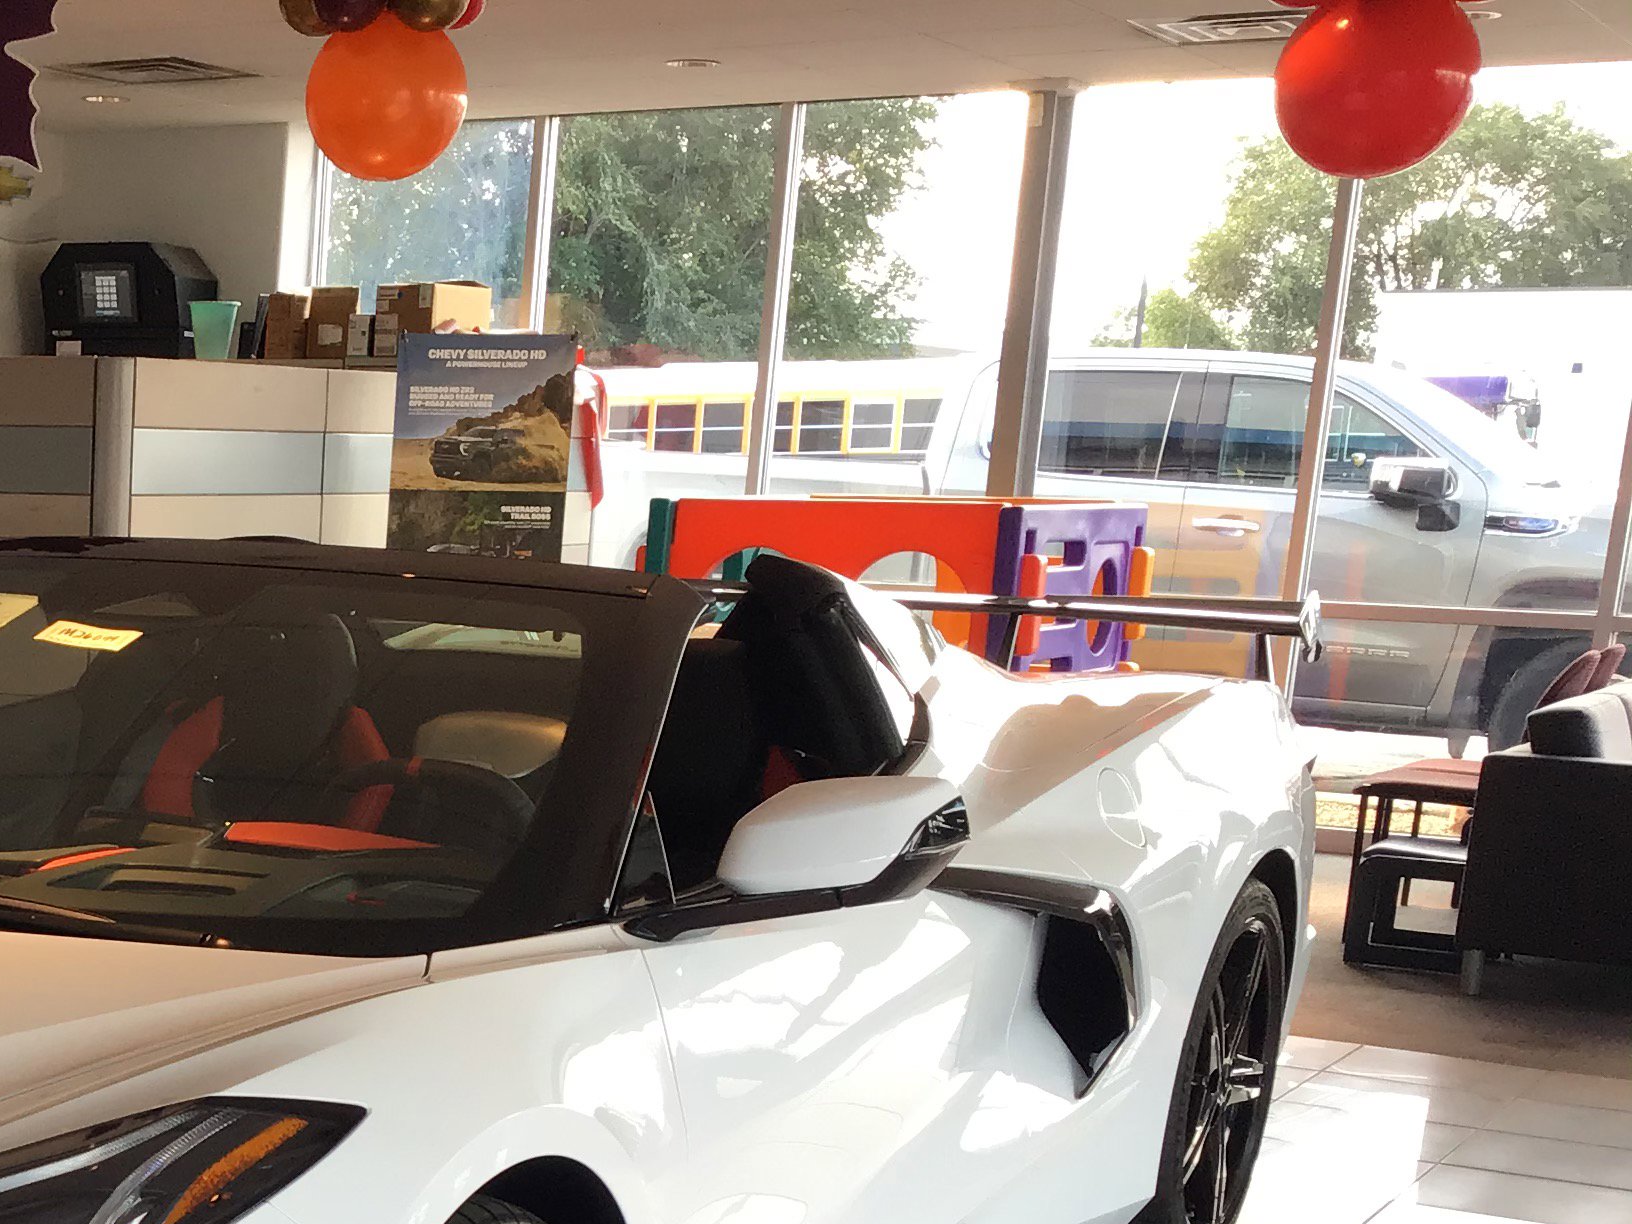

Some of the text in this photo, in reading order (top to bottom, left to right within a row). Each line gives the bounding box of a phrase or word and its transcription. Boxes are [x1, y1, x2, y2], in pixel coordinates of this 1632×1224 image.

[428, 348, 547, 360] CHEVY SILVERADO HD
